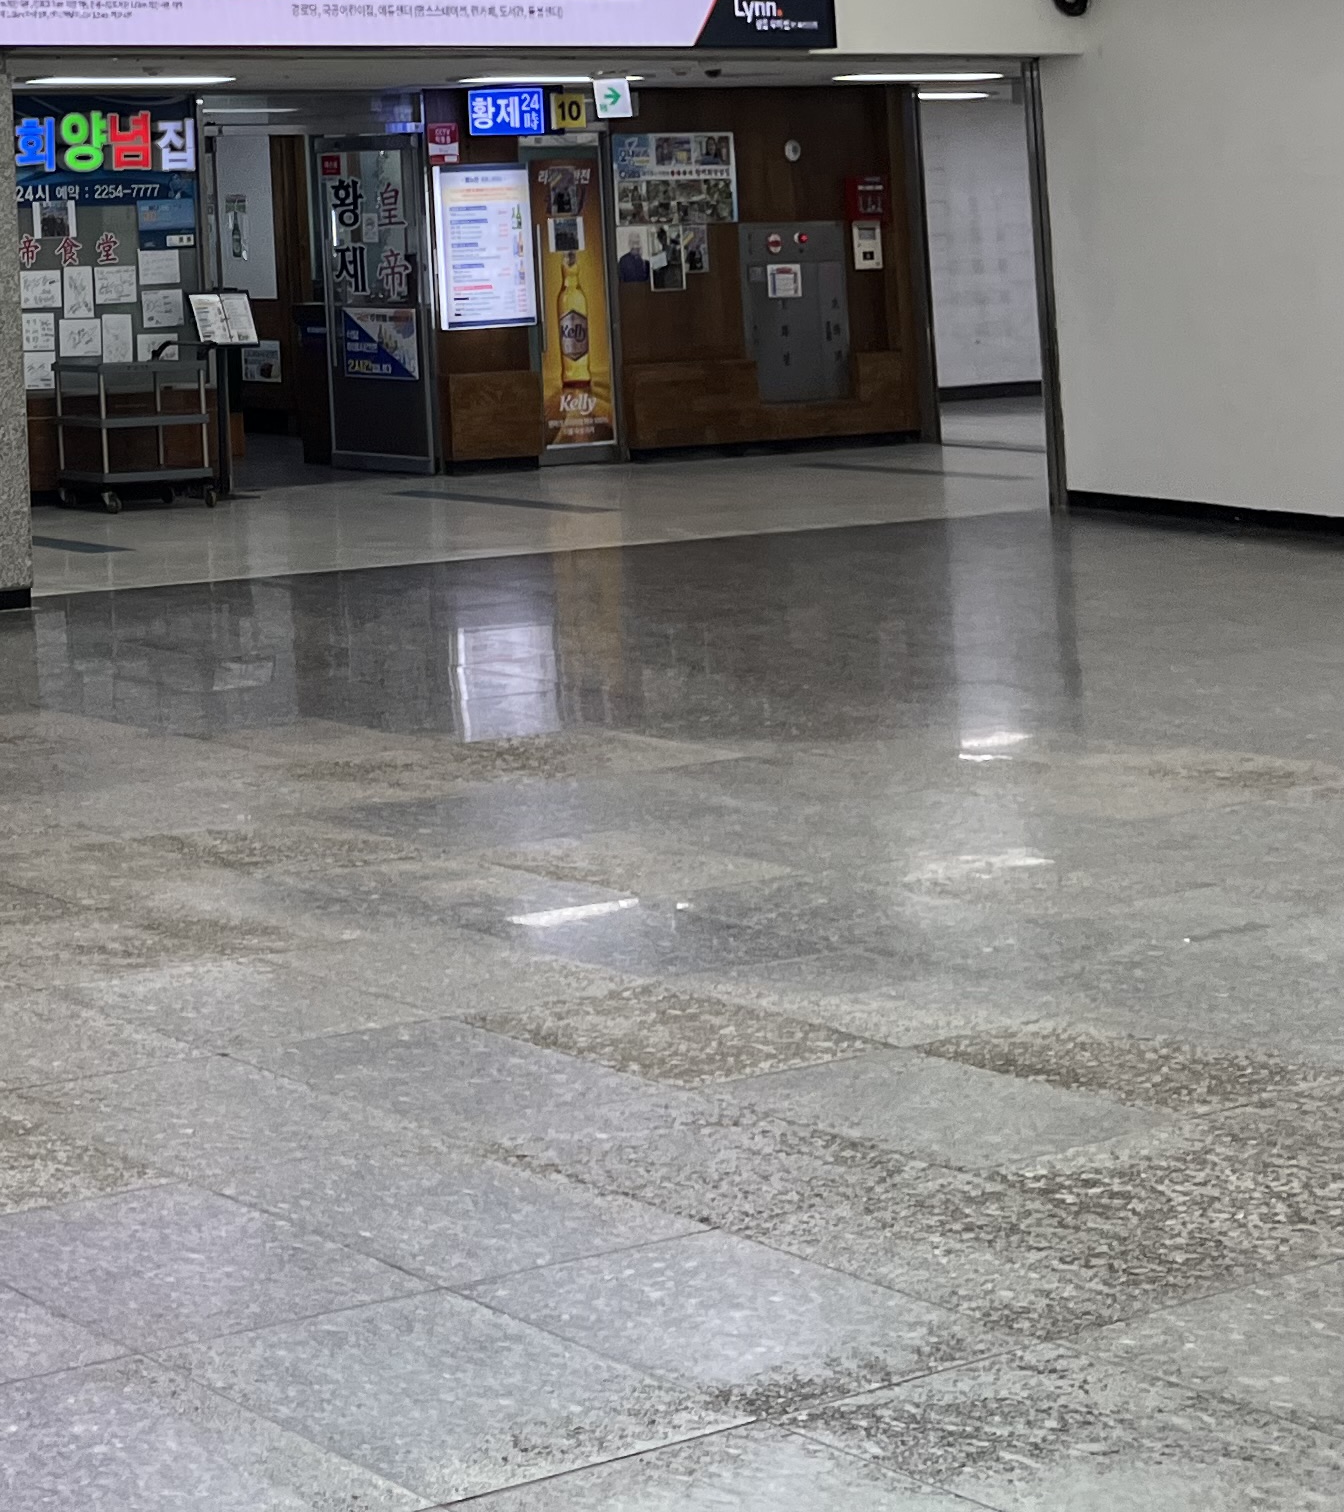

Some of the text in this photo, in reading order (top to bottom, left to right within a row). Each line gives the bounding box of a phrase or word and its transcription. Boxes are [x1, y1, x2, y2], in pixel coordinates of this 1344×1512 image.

[470, 92, 540, 131] 황제 24
[558, 101, 581, 122] 10
[15, 110, 197, 172] 회양념집
[15, 182, 161, 204] 24시 예약 2254-7777
[559, 394, 597, 415] Kelly
